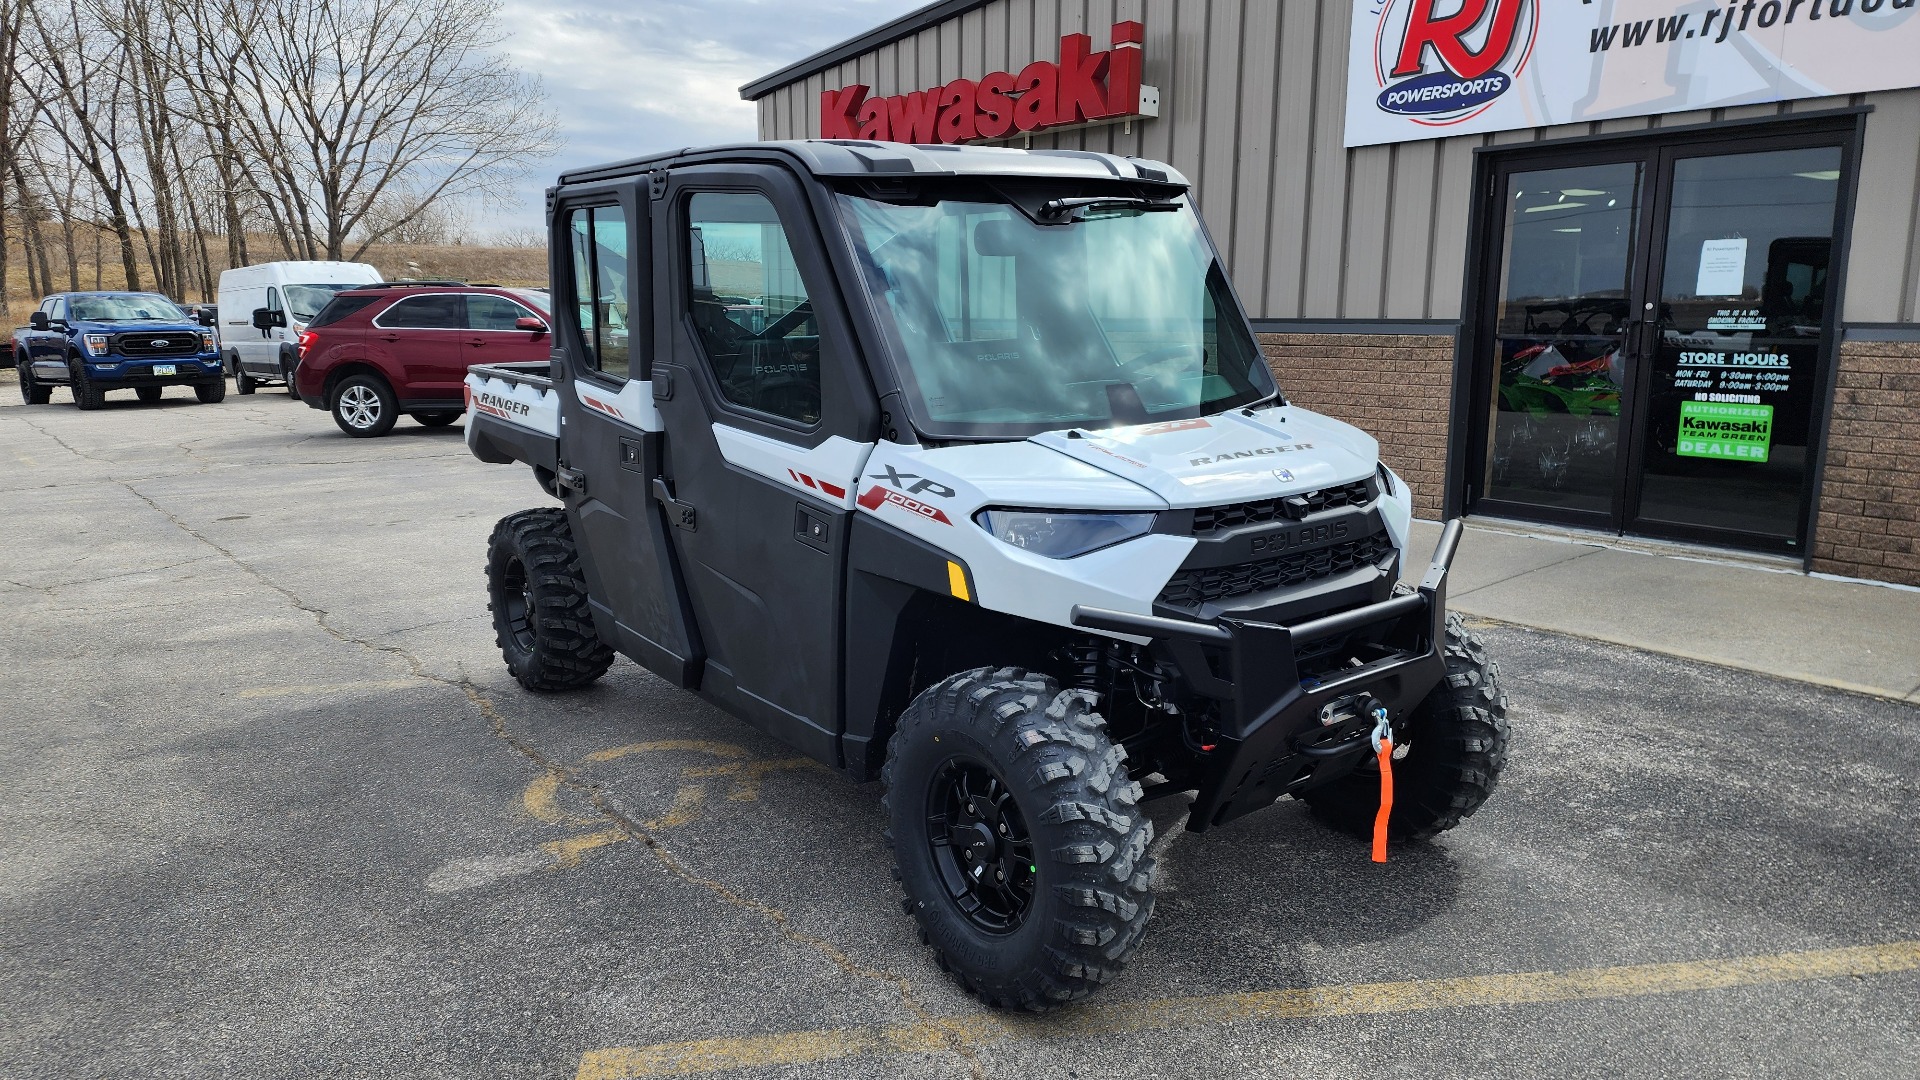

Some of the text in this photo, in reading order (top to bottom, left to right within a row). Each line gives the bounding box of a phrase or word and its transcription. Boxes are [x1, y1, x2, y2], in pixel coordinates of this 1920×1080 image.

[821, 20, 1144, 144] Kawasaki
[1386, 76, 1504, 106] POWERSPORTS
[977, 352, 1020, 361] POLARIS
[1679, 352, 1790, 366] STORE HOURS
[754, 363, 808, 375] POLARIS
[1674, 379, 1713, 388] SATURDAY
[480, 393, 530, 416] RANGER
[1695, 392, 1760, 404] NO SOLICITING
[1685, 405, 1769, 416] AUTHORIZED
[1683, 416, 1768, 433] Kawasaki
[1682, 430, 1766, 441] TEAM GREEN
[1190, 443, 1316, 466] RANGER
[1680, 441, 1765, 458] DEALER
[867, 464, 956, 498] XP
[884, 490, 937, 517] 1000
[1250, 520, 1349, 555] POLARIS
